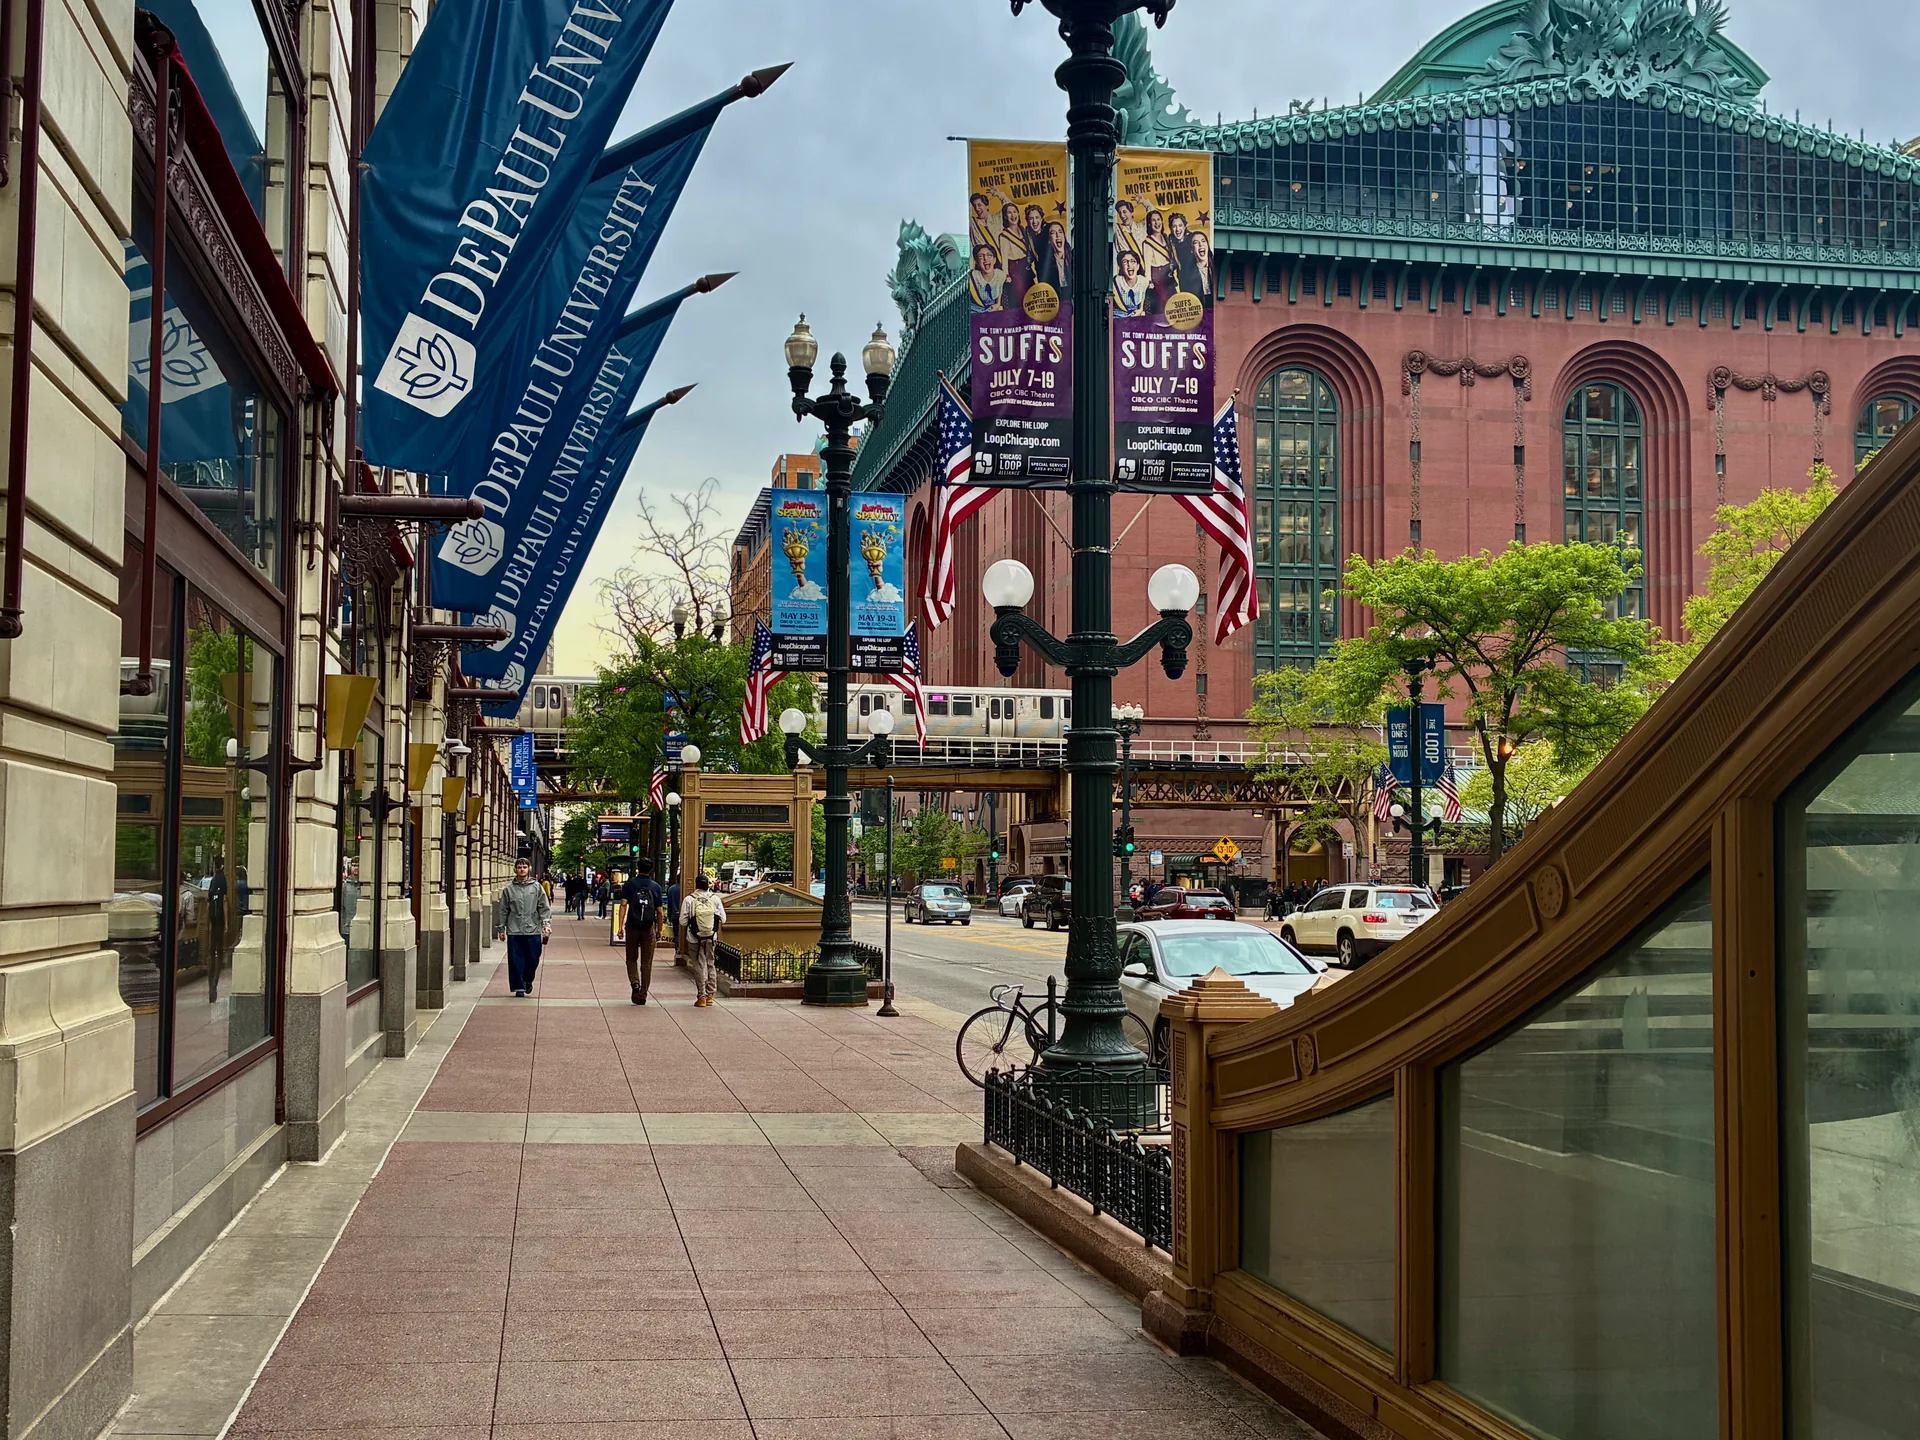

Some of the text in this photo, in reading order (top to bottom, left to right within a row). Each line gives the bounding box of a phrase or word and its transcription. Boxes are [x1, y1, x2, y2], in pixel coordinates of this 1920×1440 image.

[420, 0, 631, 331] DEPAUL UNIV
[993, 164, 1018, 173] POWERFUL
[1020, 161, 1039, 169] WOMAN
[979, 167, 1057, 187] MORE POWERFUL
[1138, 172, 1163, 181] POWERFUL
[1165, 170, 1183, 178] WOMAN
[1010, 180, 1059, 198] WOMEN.
[1125, 176, 1201, 195] MORE POWERFUL
[1155, 189, 1202, 206] WOMEN.
[1004, 324, 1043, 334] AWARD-WINNING
[1044, 326, 1064, 334] MUSICAL
[469, 165, 657, 518] DEPAUL UNIVERSITY
[979, 333, 1063, 365] SUFFS
[1121, 340, 1206, 370] SUFFS
[990, 368, 1022, 389] JULY
[1131, 376, 1163, 393] JULY
[990, 389, 1055, 398] CIBC CIBC Theatre
[542, 343, 633, 502] UNIVERSITY
[995, 418, 1049, 430] EXPLORE THE LOOP
[1137, 426, 1192, 435] EXPLORE THE LOOP
[984, 432, 1060, 448] LoopChicago.com
[1127, 439, 1203, 454] LoopChicago.com
[999, 460, 1022, 470] LOOP
[1142, 466, 1165, 476] LOOP
[780, 611, 819, 620] MAY 19-31
[877, 614, 896, 622] 19-31
[778, 642, 820, 651] LoopChicago.com
[856, 644, 898, 653] LoopChicago.com
[1393, 749, 1408, 758] HOOD
[1425, 732, 1439, 764] LOOP
[729, 806, 764, 814] SUBWAY
